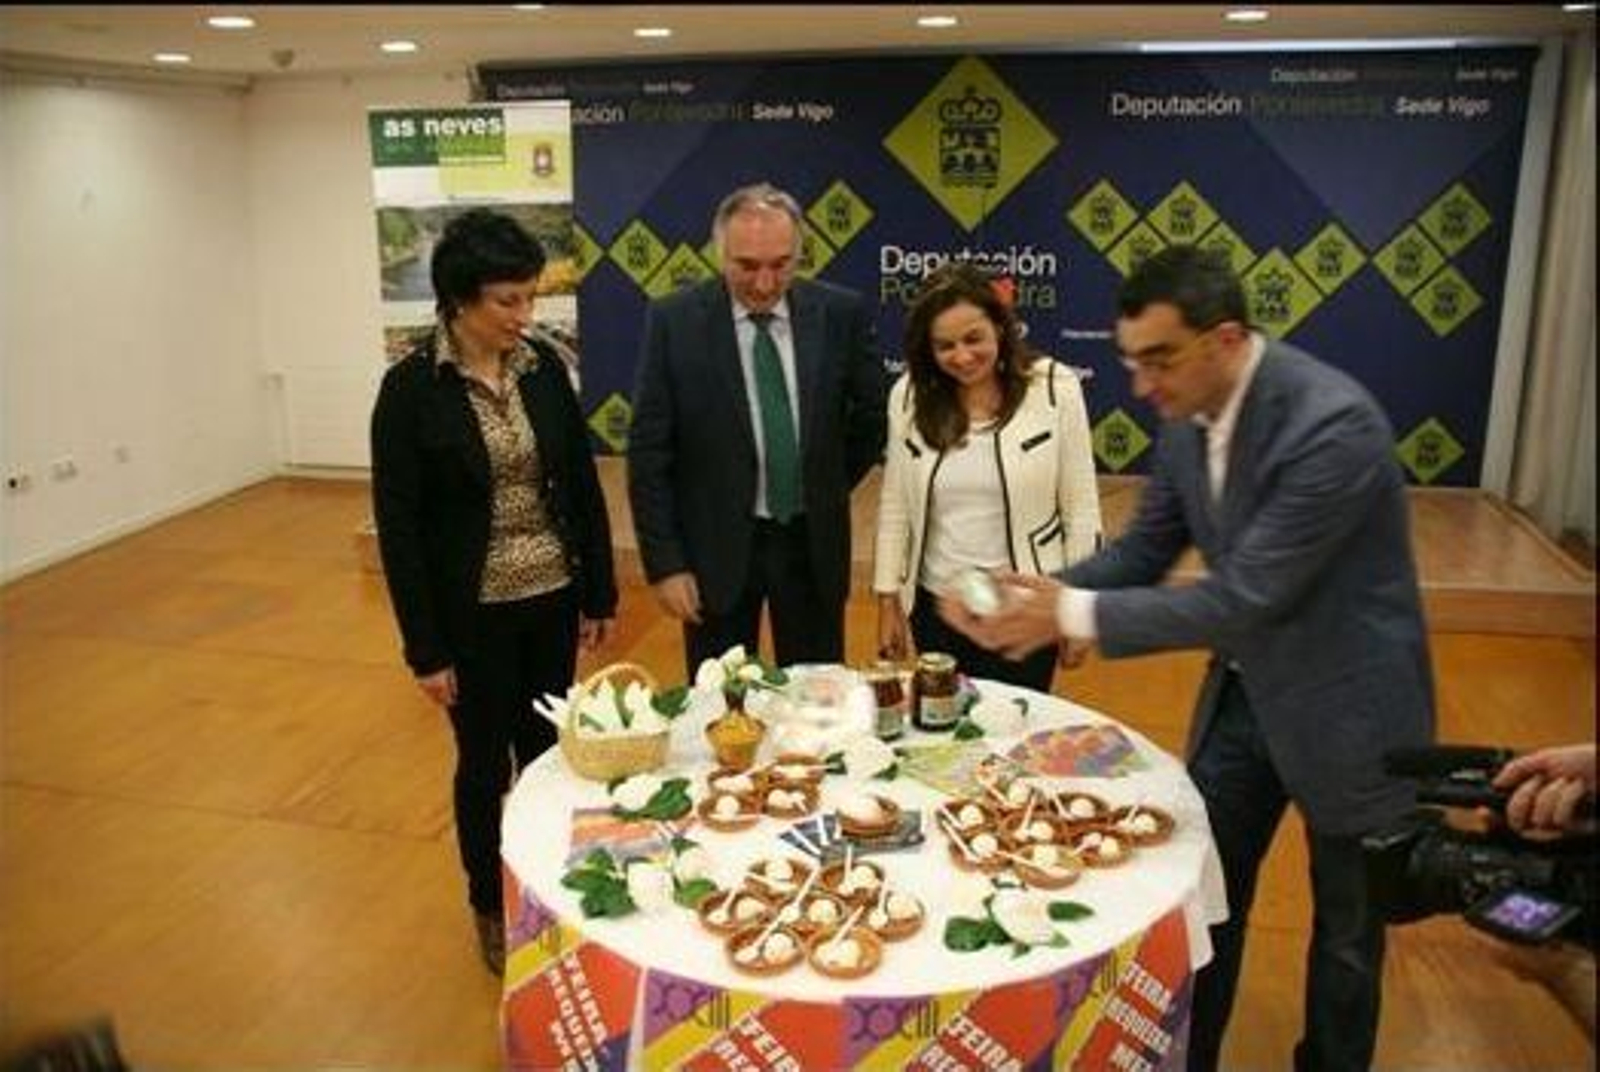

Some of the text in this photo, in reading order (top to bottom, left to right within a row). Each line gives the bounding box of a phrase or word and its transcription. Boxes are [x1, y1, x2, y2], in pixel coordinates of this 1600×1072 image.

[571, 102, 625, 123] ación
[752, 101, 795, 120] Sede
[797, 101, 835, 123] Vigo
[1111, 92, 1242, 119] Deputación
[1395, 96, 1444, 115] Sede
[1446, 96, 1489, 119] Vigo
[382, 115, 503, 138] as neves
